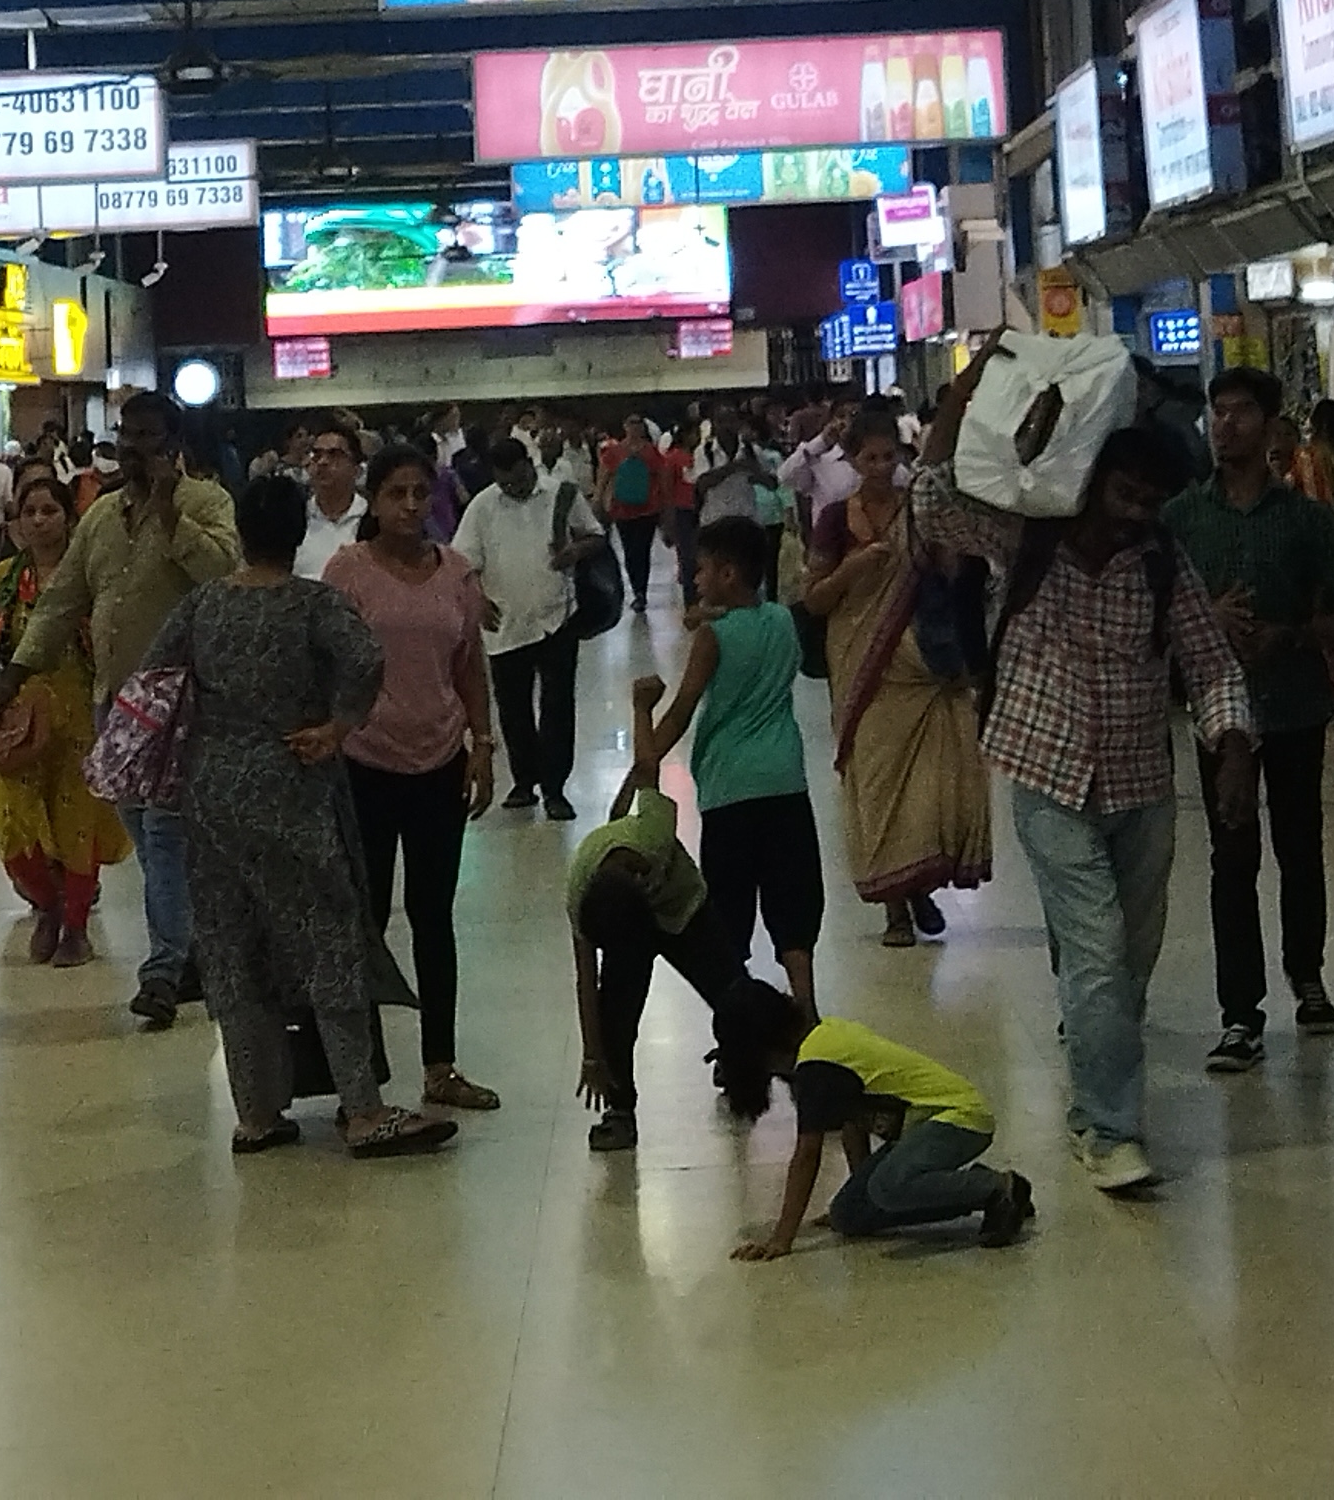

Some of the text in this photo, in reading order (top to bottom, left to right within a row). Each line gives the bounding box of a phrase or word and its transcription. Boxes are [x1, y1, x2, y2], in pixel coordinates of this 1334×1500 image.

[770, 89, 839, 110] GULAB
[44, 130, 74, 155] 69
[84, 128, 147, 153] 7338
[99, 190, 158, 210] 08779
[196, 185, 244, 205] 7338
